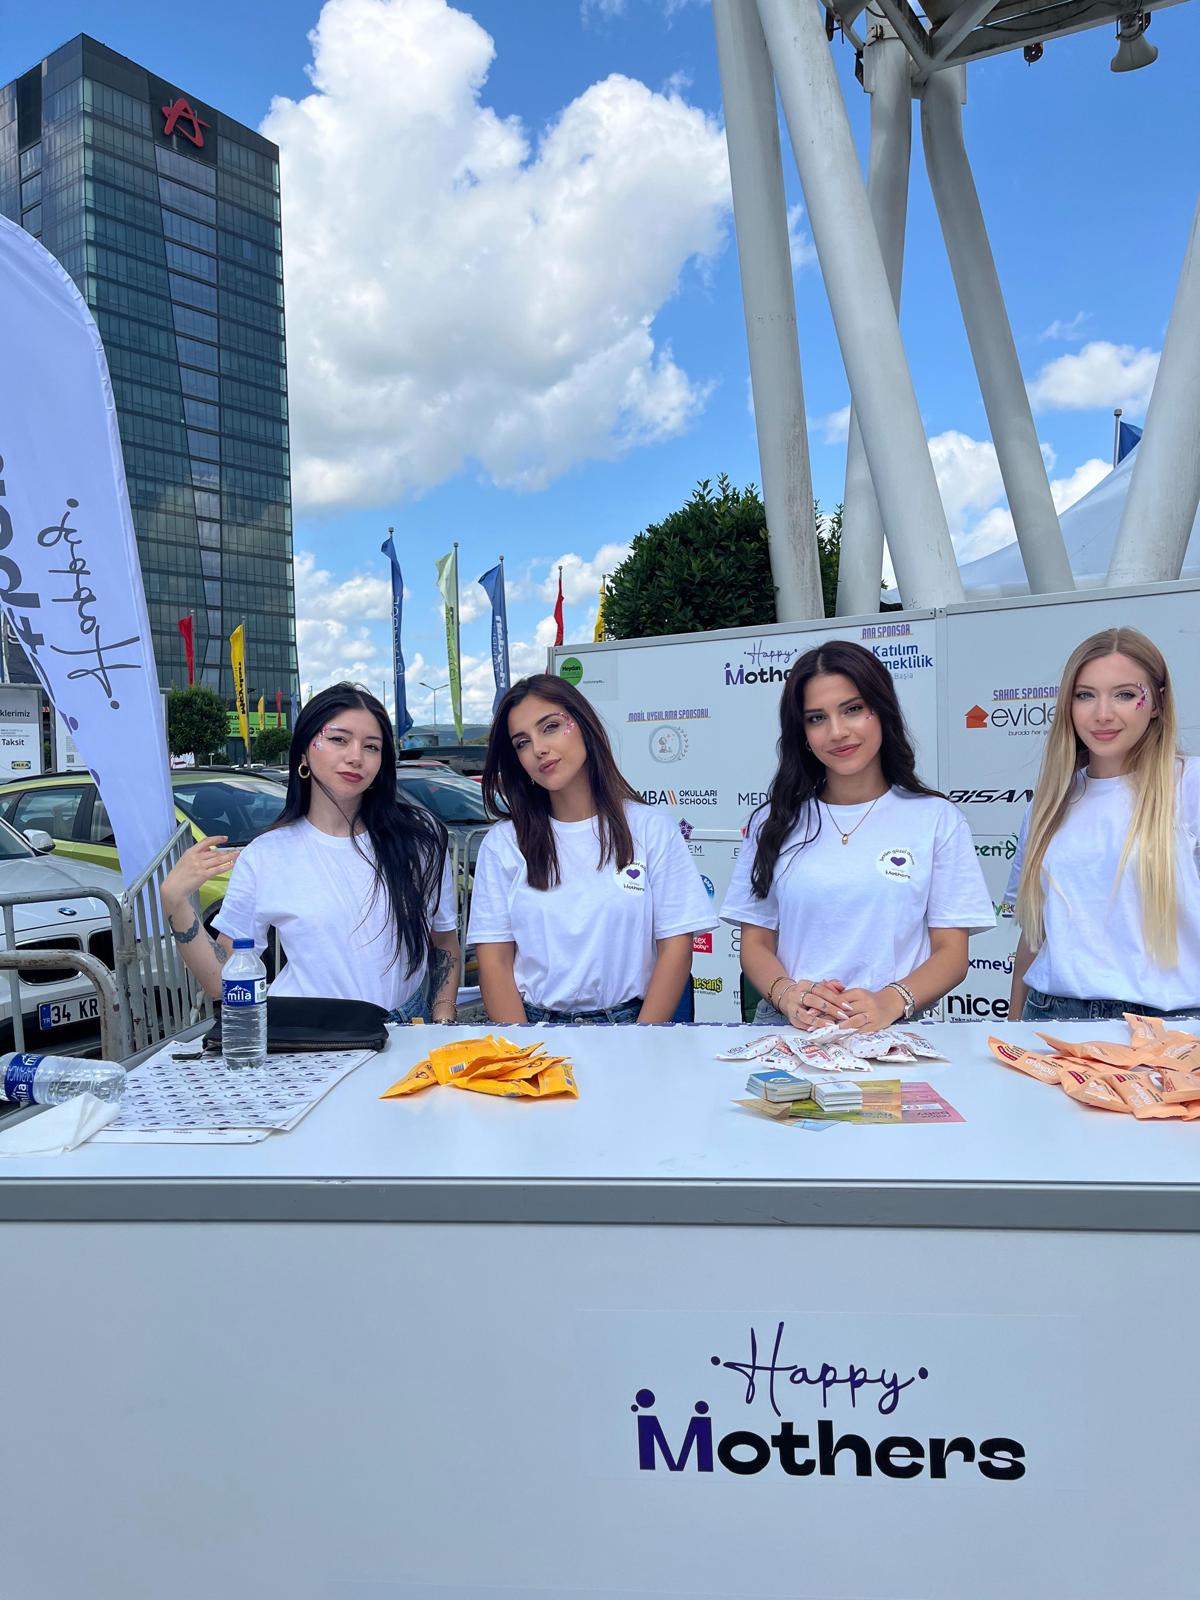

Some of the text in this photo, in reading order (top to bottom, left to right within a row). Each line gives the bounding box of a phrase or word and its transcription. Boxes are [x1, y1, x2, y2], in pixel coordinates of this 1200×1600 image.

[877, 624, 911, 637] SPONSOR
[744, 640, 798, 667] Happy
[872, 643, 919, 657] Katılım
[993, 688, 1020, 700] SAHNE
[678, 708, 709, 720] SPONSORU
[2, 738, 25, 746] Taksit
[227, 990, 252, 1001] mila
[51, 998, 99, 1024] 34 KR
[947, 994, 1010, 1018] nice
[711, 1321, 929, 1417] Happy
[631, 1390, 1027, 1481] Mothers
